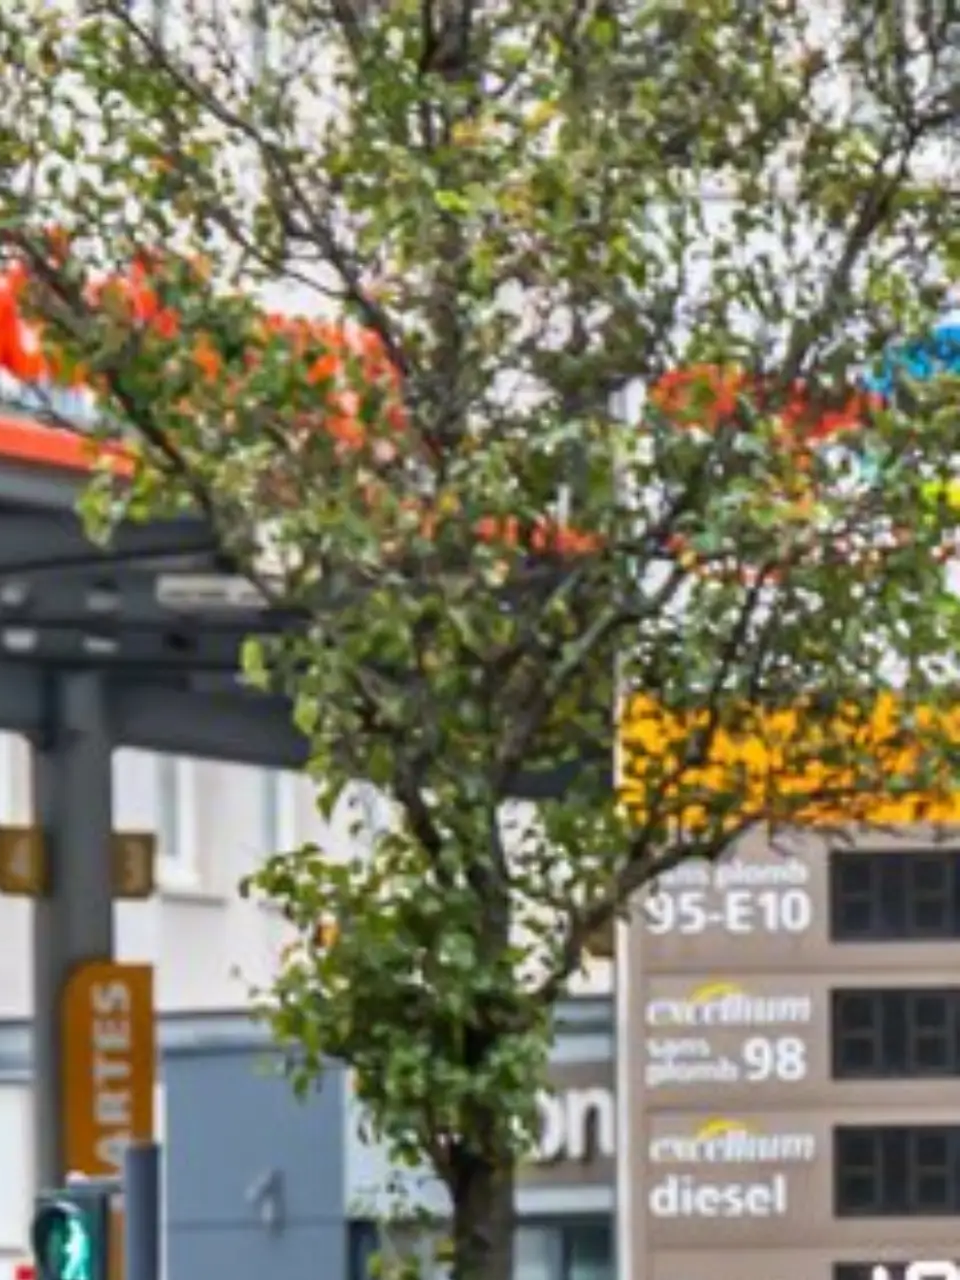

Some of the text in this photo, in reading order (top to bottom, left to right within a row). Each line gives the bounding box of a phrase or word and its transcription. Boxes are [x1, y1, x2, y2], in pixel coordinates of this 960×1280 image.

[644, 889, 812, 935] 95-E10
[92, 980, 133, 1182] ARTES
[742, 1035, 807, 1083] 98
[648, 1172, 788, 1218] diesel
